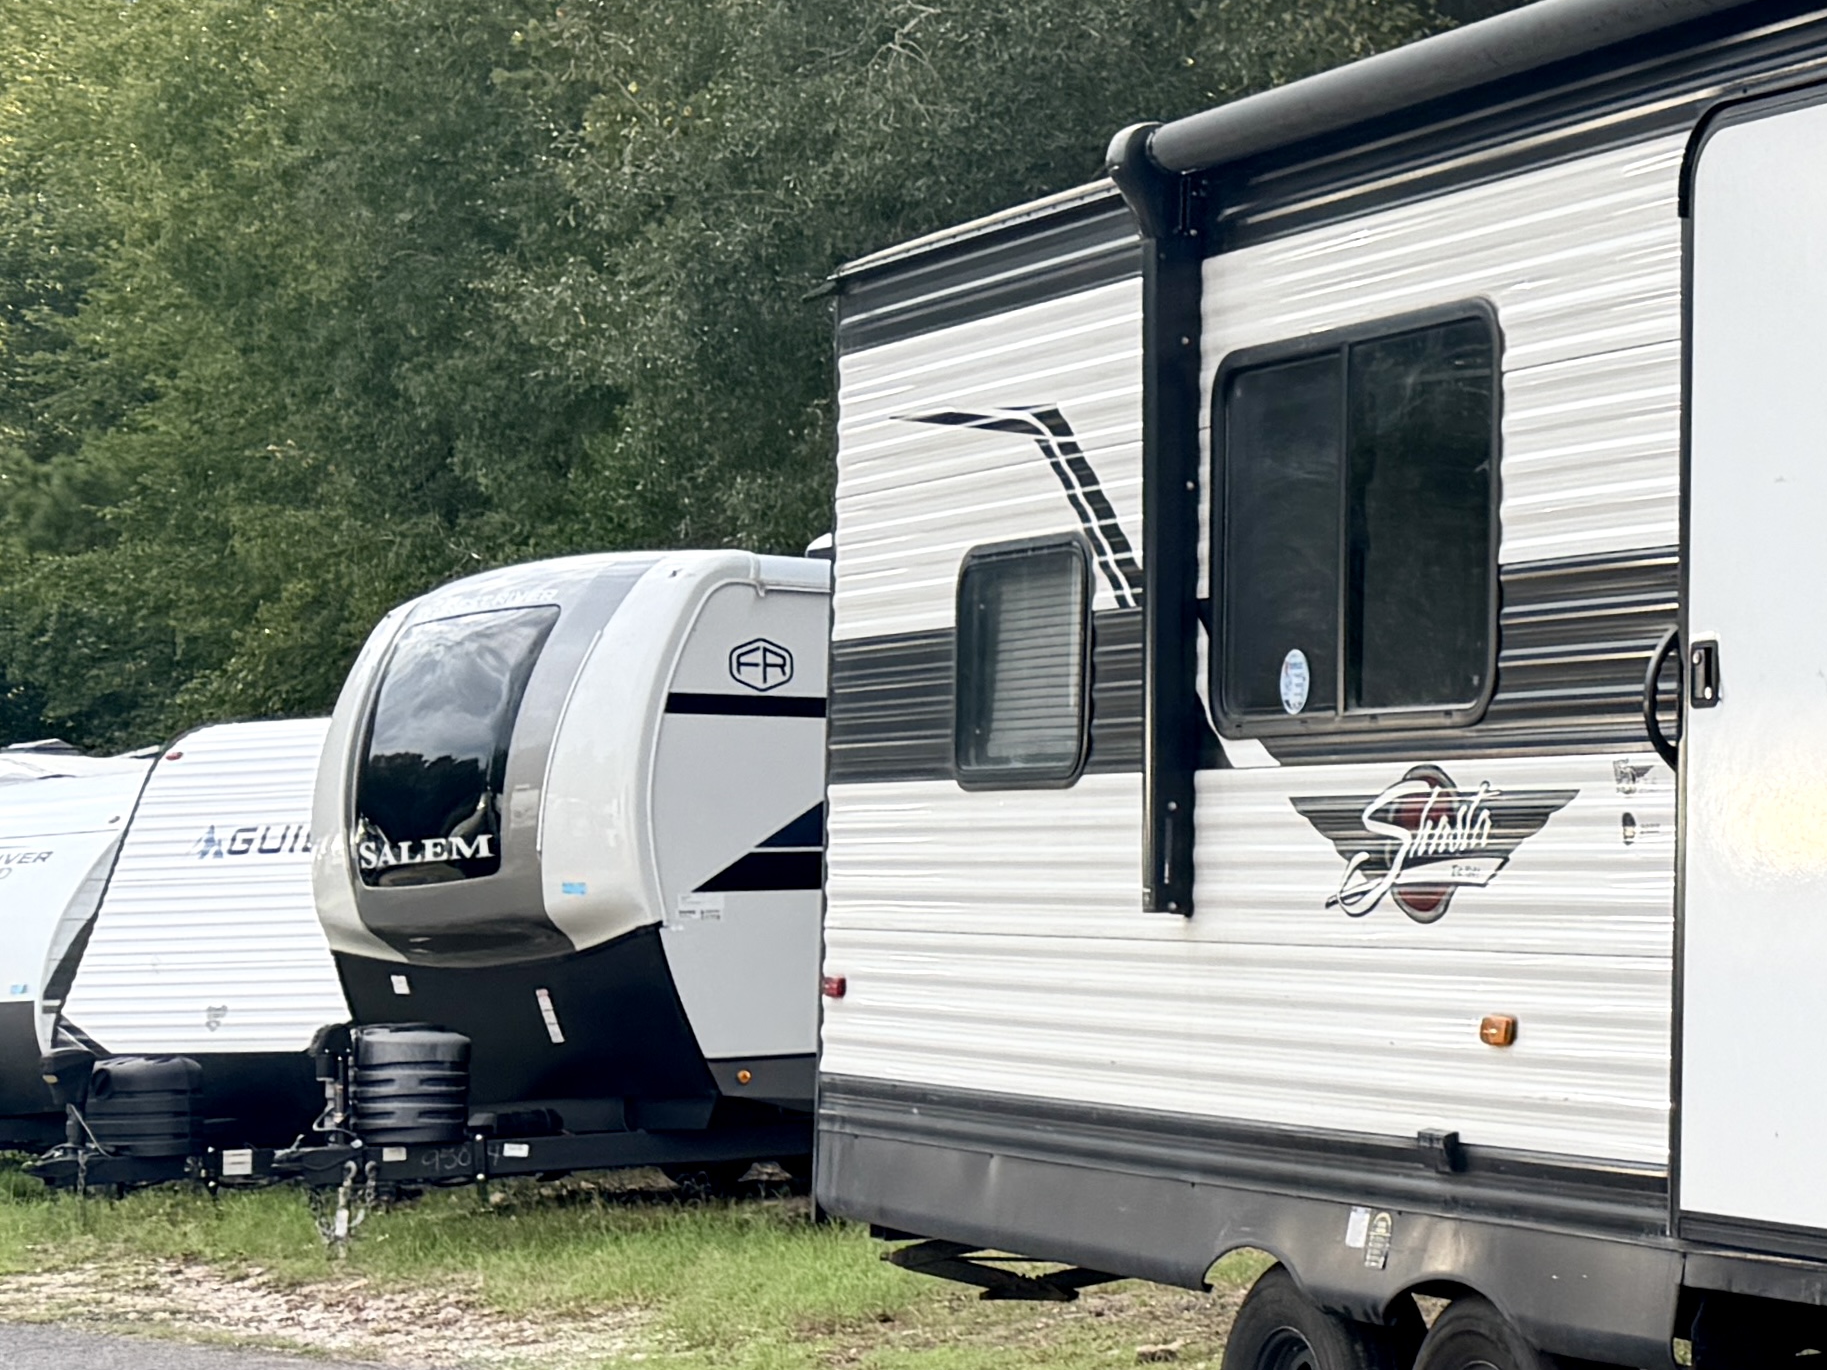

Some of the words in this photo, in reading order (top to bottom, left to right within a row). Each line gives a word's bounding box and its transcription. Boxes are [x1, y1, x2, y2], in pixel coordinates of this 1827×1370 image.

[736, 645, 787, 685] FR
[359, 834, 497, 869] SALEM
[1337, 778, 1501, 917] Shasta
